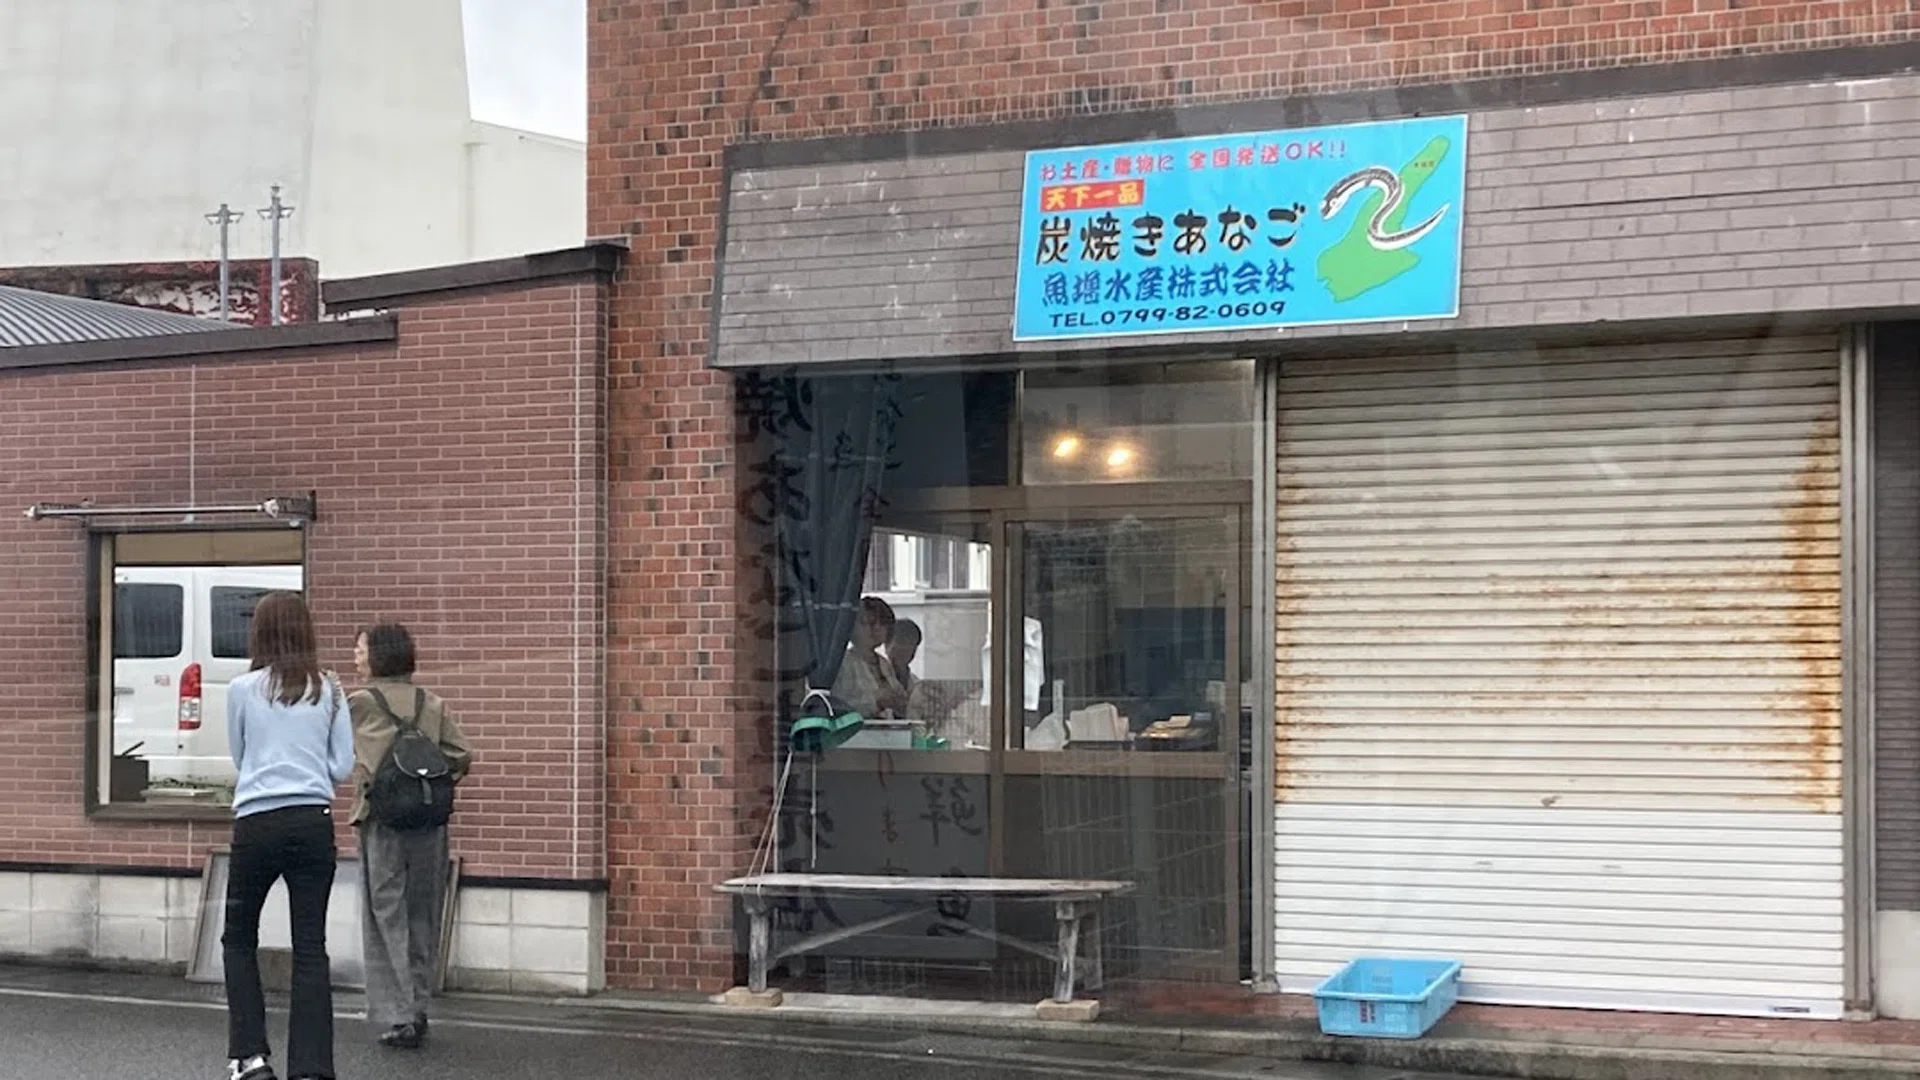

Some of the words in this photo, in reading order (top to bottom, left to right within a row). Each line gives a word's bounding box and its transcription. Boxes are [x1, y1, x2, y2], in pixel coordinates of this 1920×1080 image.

[1045, 182, 1138, 210] 天下一品
[1036, 203, 1306, 265] 炭焼きあなご
